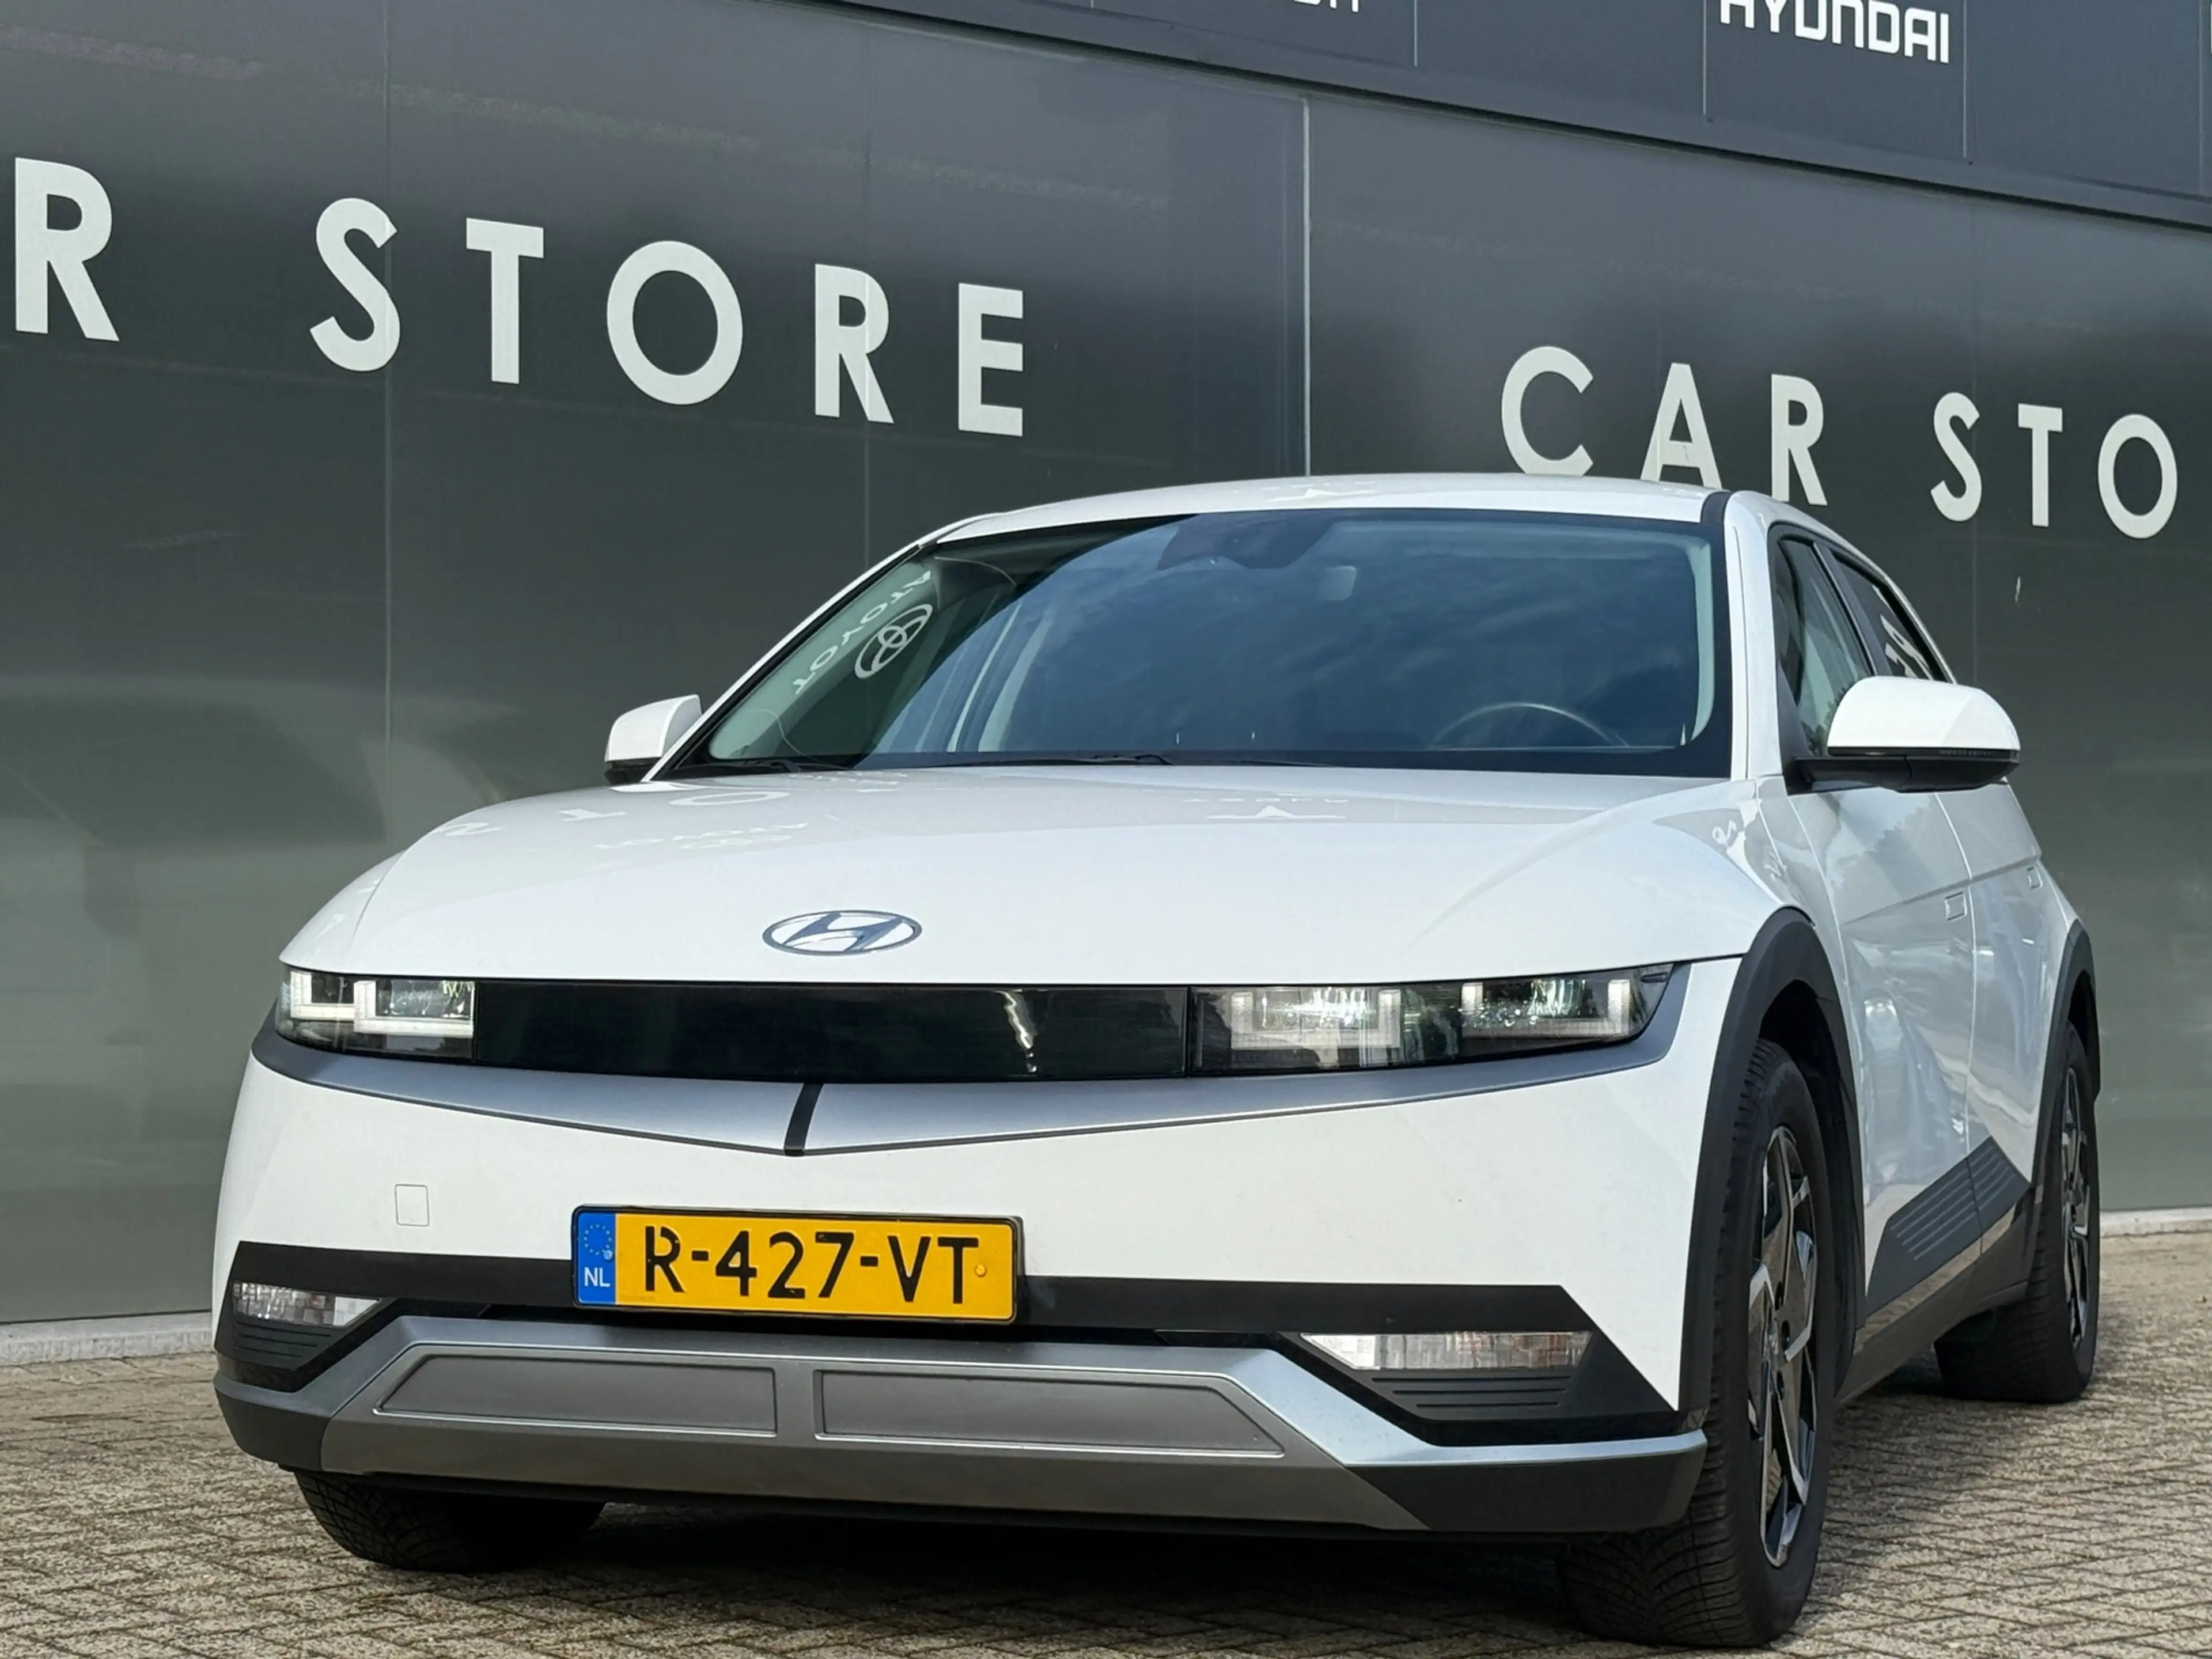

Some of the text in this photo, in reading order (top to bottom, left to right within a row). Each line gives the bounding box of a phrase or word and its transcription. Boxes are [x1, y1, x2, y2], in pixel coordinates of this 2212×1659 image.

[15, 157, 1023, 437] R STORE
[1501, 346, 2177, 538] CAR STO
[584, 1267, 611, 1287] NL
[645, 1225, 979, 1304] R-427-VT
